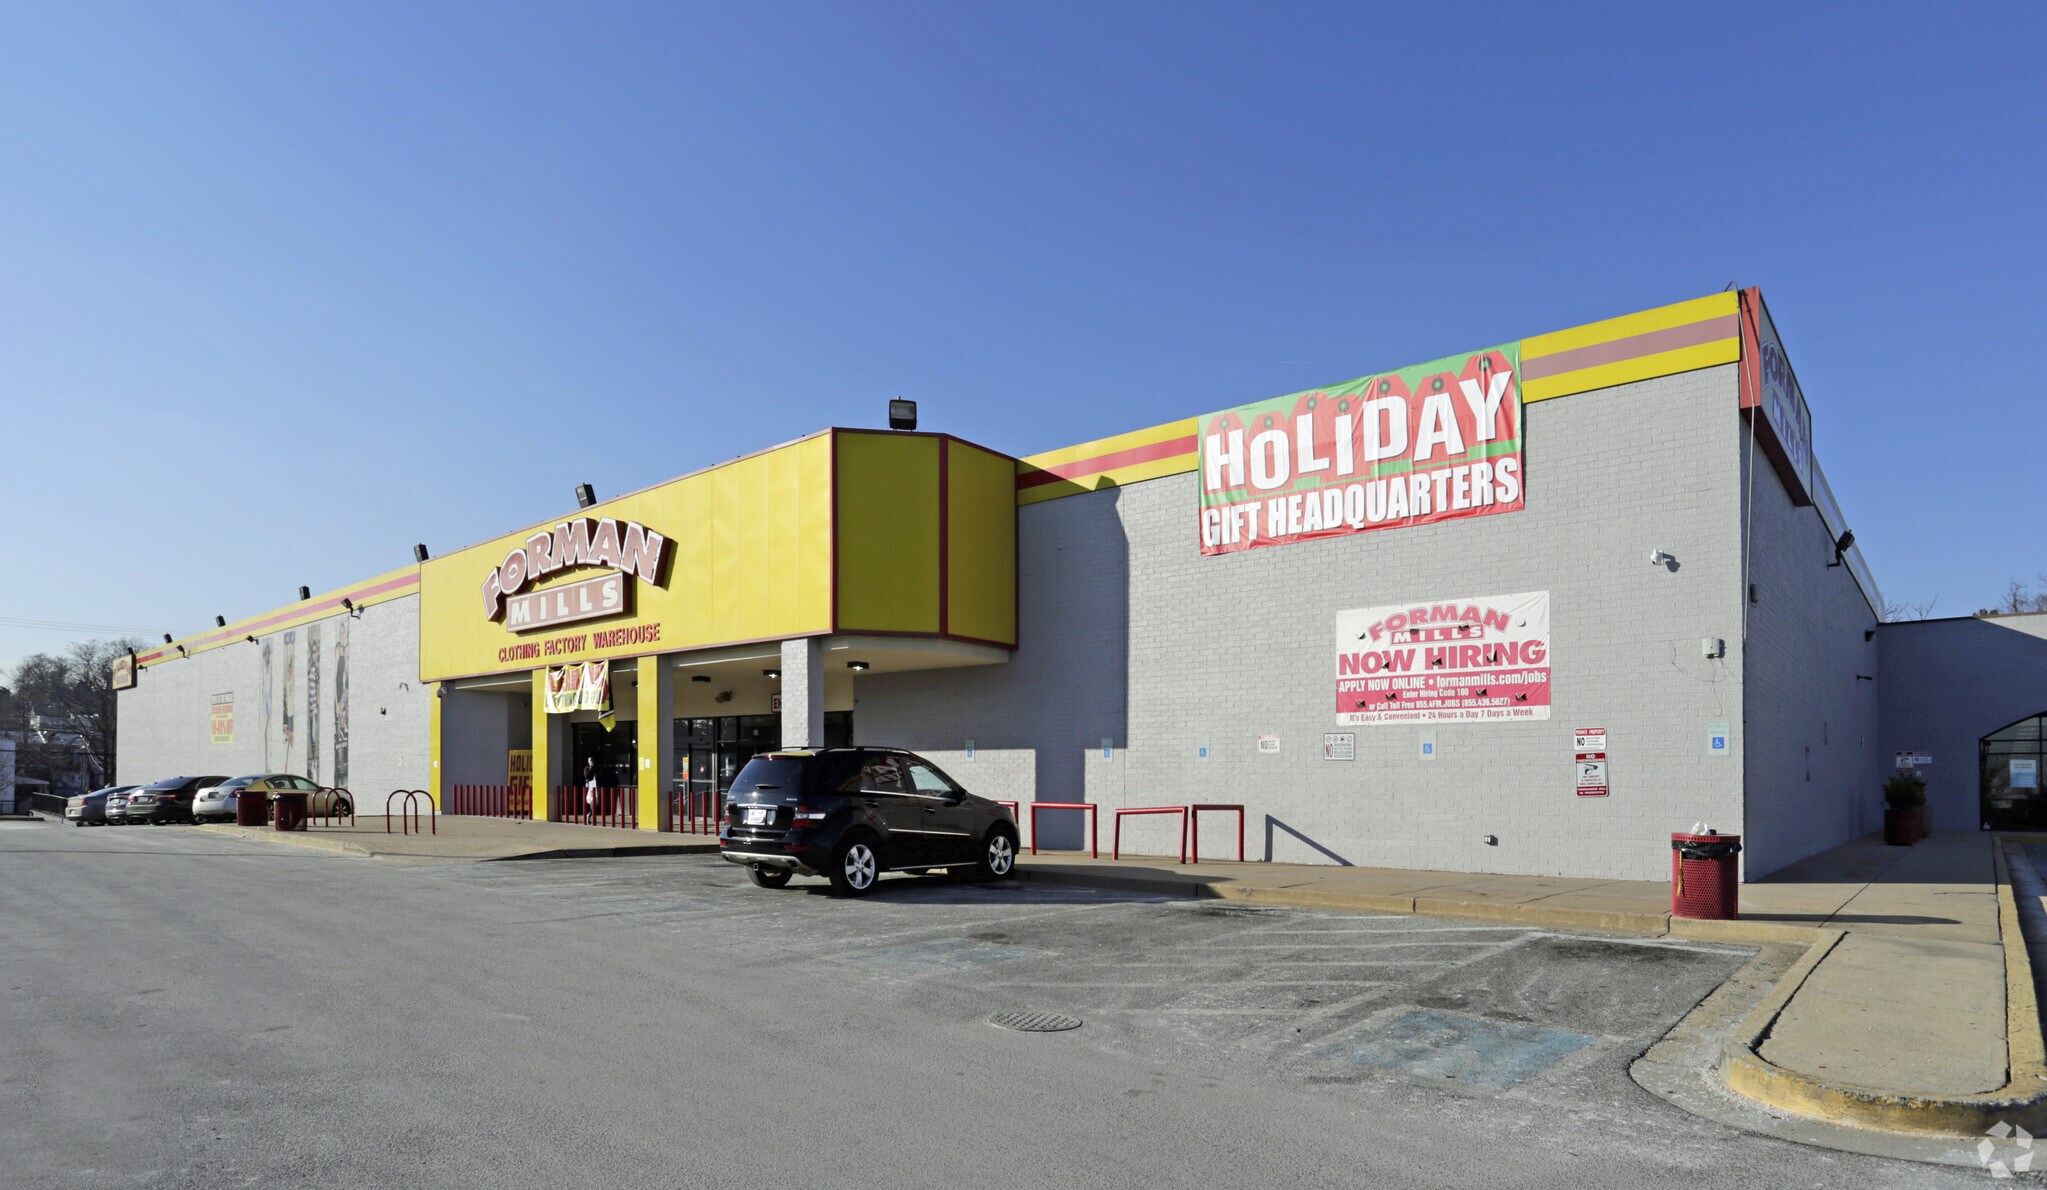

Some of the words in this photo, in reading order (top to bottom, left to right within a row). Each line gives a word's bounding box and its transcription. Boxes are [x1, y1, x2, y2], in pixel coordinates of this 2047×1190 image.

[1206, 370, 1513, 491] HOLIDAY
[1773, 393, 1803, 475] MILLS
[1202, 501, 1262, 547] GIFT
[1268, 458, 1519, 537] HEADQUARTERS
[481, 517, 670, 621] FORMAN
[511, 580, 618, 625] MILLS
[1367, 604, 1511, 642] FORMAN
[1393, 626, 1482, 643] MILLS
[498, 643, 540, 662] CLOTHING
[544, 635, 587, 655] FACTORY
[593, 623, 661, 649] WAREHOUSE
[1339, 648, 1416, 675] NOW
[1425, 639, 1546, 670] HIRING
[1339, 680, 1366, 692] APPLY
[1368, 679, 1390, 691] NOW
[1392, 677, 1426, 689] ONLINE
[1437, 671, 1547, 688] formanmills.com/jobs
[1420, 690, 1438, 698] Hiring
[1439, 689, 1455, 697] Code
[1457, 688, 1469, 696] 100
[1361, 713, 1375, 721] Easy
[1384, 712, 1420, 720] Convenient
[1438, 711, 1457, 719] Hours
[1466, 711, 1479, 719] Day
[1487, 709, 1504, 718] Days
[1513, 708, 1533, 716] Week
[1261, 740, 1268, 749] NO
[1326, 743, 1333, 757] NO
[1577, 737, 1585, 746] NO
